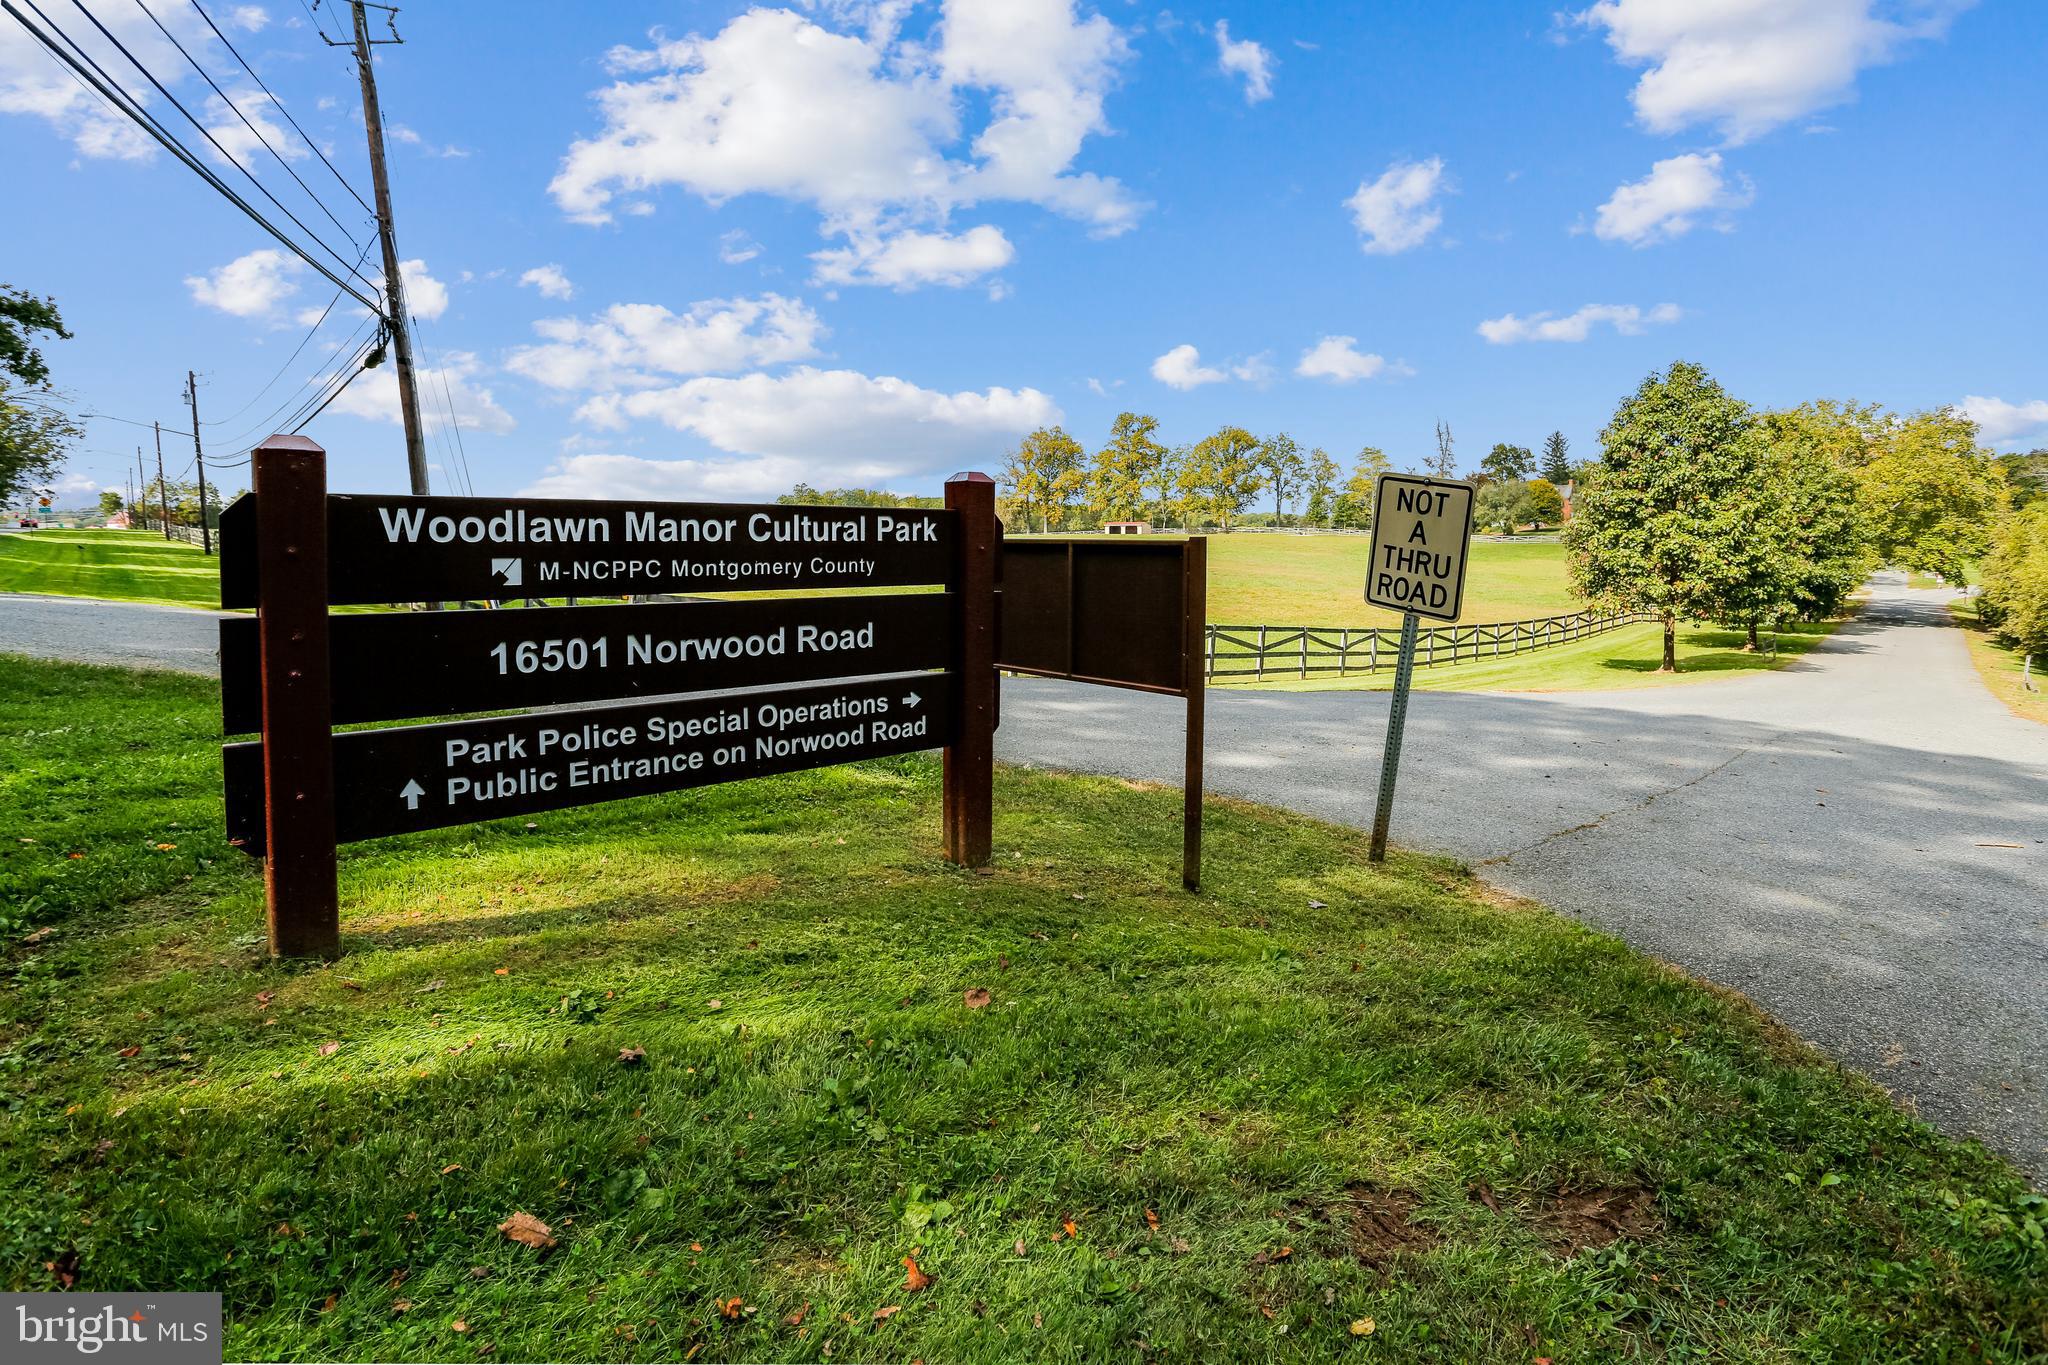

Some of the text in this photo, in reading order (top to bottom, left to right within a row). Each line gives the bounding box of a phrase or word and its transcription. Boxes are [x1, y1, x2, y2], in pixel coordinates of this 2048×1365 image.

[1397, 487, 1450, 517] NOT
[379, 506, 938, 543] Woodlawn Manor Cultural Park
[1408, 520, 1427, 545] A
[540, 556, 875, 581] M-NCPPC Montgomery County
[1383, 544, 1452, 579] THRU
[1376, 572, 1448, 608] ROAD
[490, 621, 873, 675] 16501 Norwood Road
[446, 696, 889, 767] Park Police Special Operations
[447, 715, 926, 805] Public Entrance on Norwood Road
